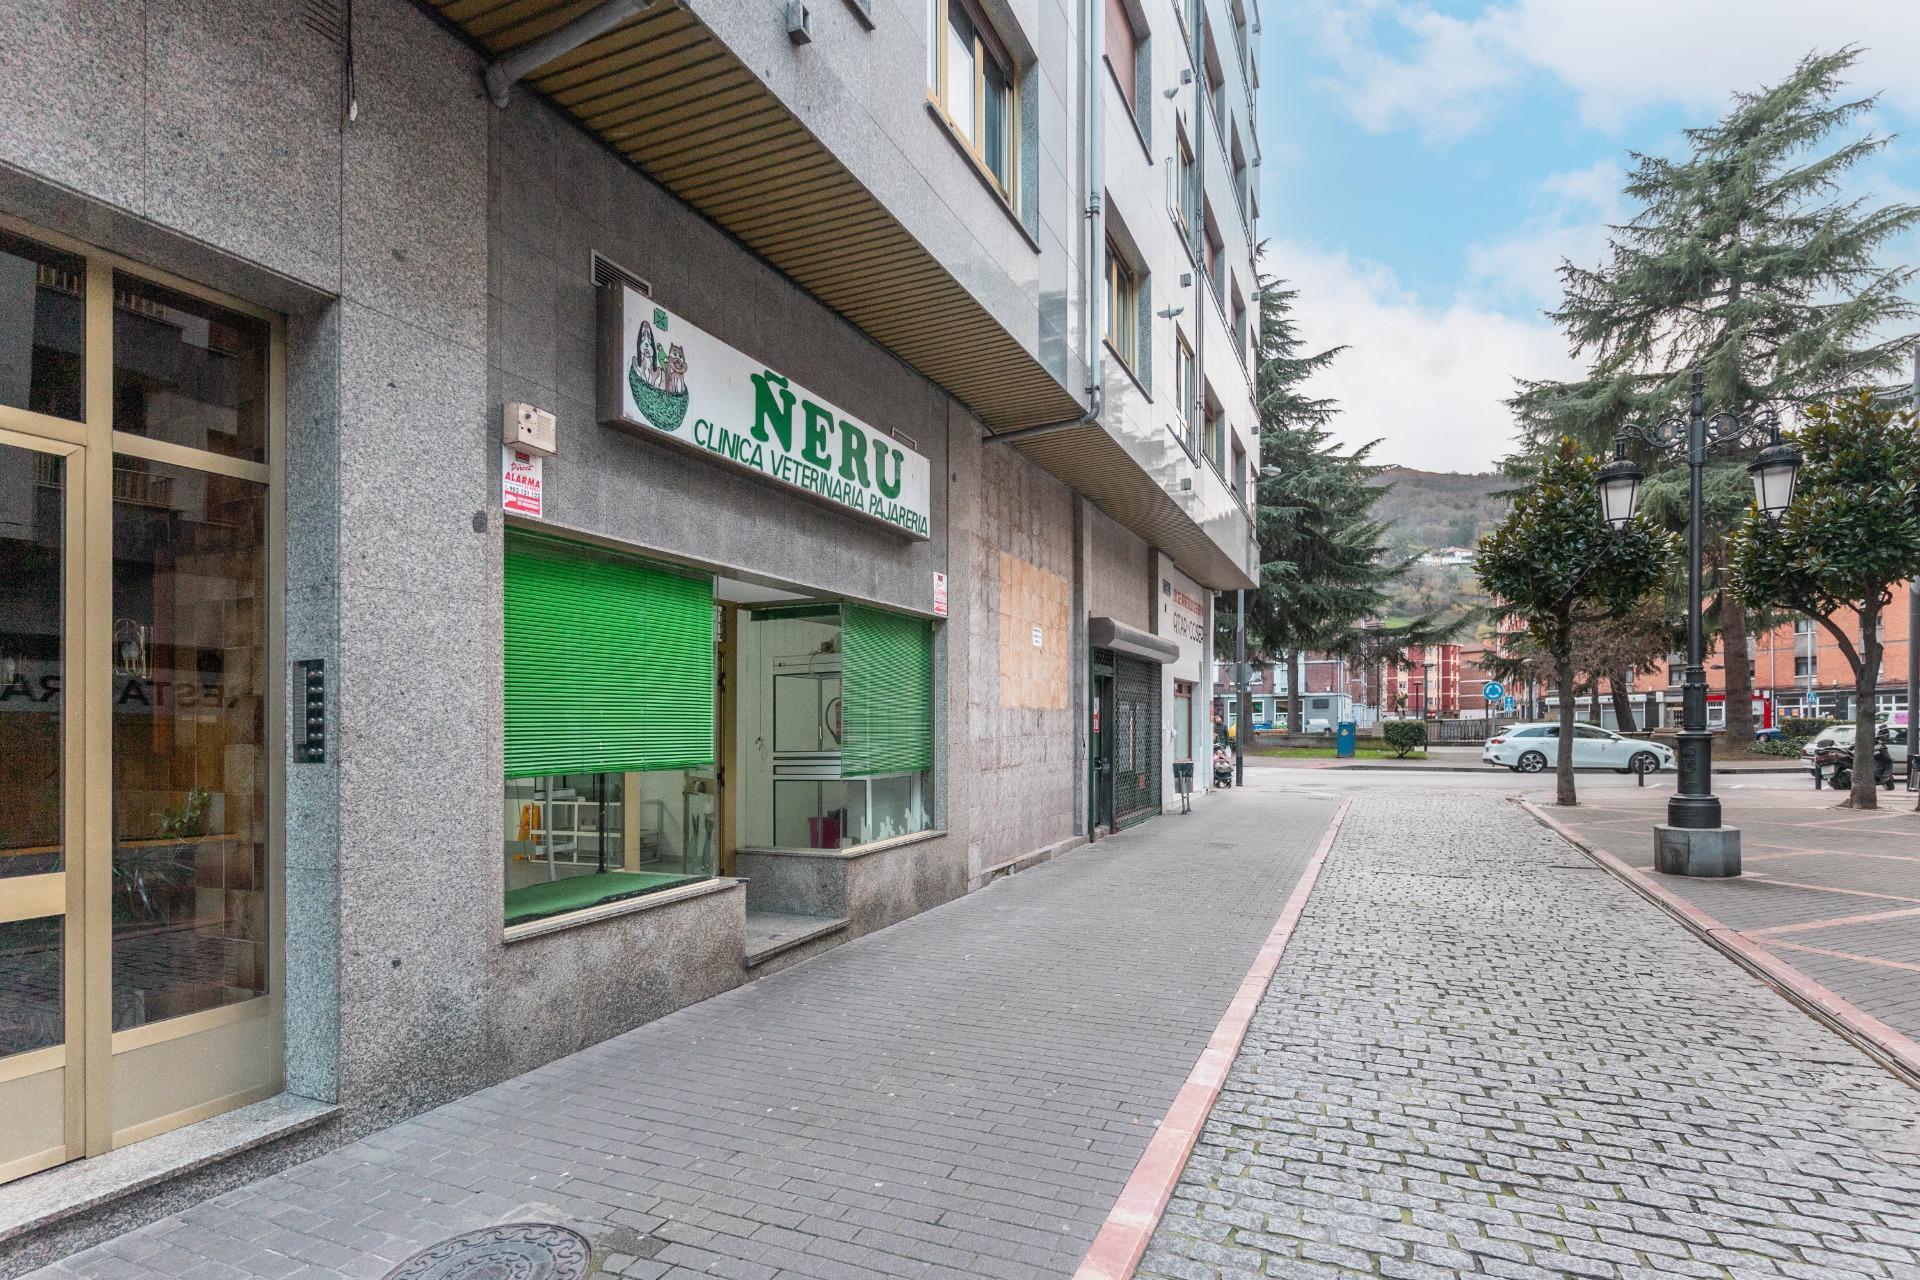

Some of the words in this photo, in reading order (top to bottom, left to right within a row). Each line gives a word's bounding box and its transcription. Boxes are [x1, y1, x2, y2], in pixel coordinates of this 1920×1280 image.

[505, 472, 540, 488] ALARMA
[694, 419, 765, 472] CLINICA
[770, 449, 866, 512] VETERINARIA
[869, 494, 929, 536] PAJARERIA
[750, 370, 904, 499] ÑERU
